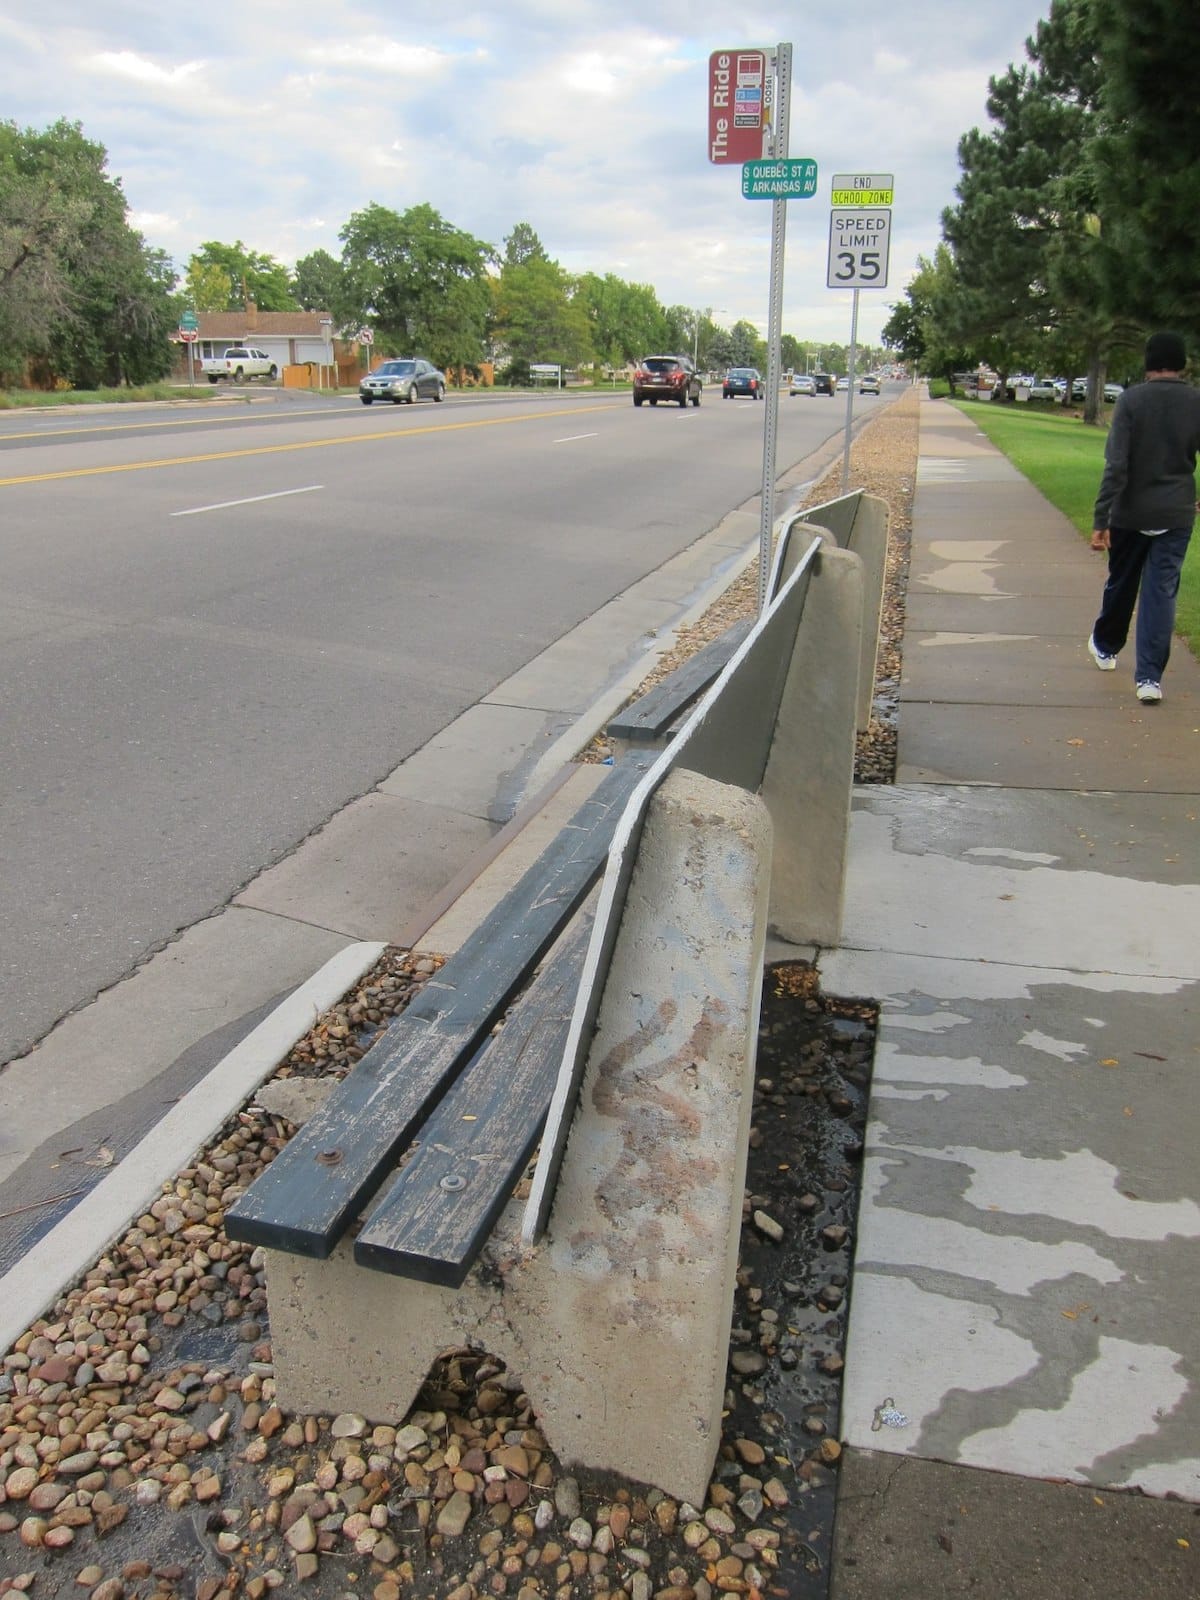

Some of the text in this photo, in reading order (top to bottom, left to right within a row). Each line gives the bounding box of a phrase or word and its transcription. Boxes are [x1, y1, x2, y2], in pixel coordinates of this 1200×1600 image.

[712, 55, 730, 161] The Ride
[743, 165, 816, 178] S QUEBEC ST AT
[743, 181, 815, 193] E ARKANSAS AV
[854, 177, 872, 189] END
[833, 191, 889, 204] SCHOOL ZONE
[835, 219, 886, 231] SPEED
[840, 235, 879, 247] LIMIT
[835, 252, 881, 281] 35
